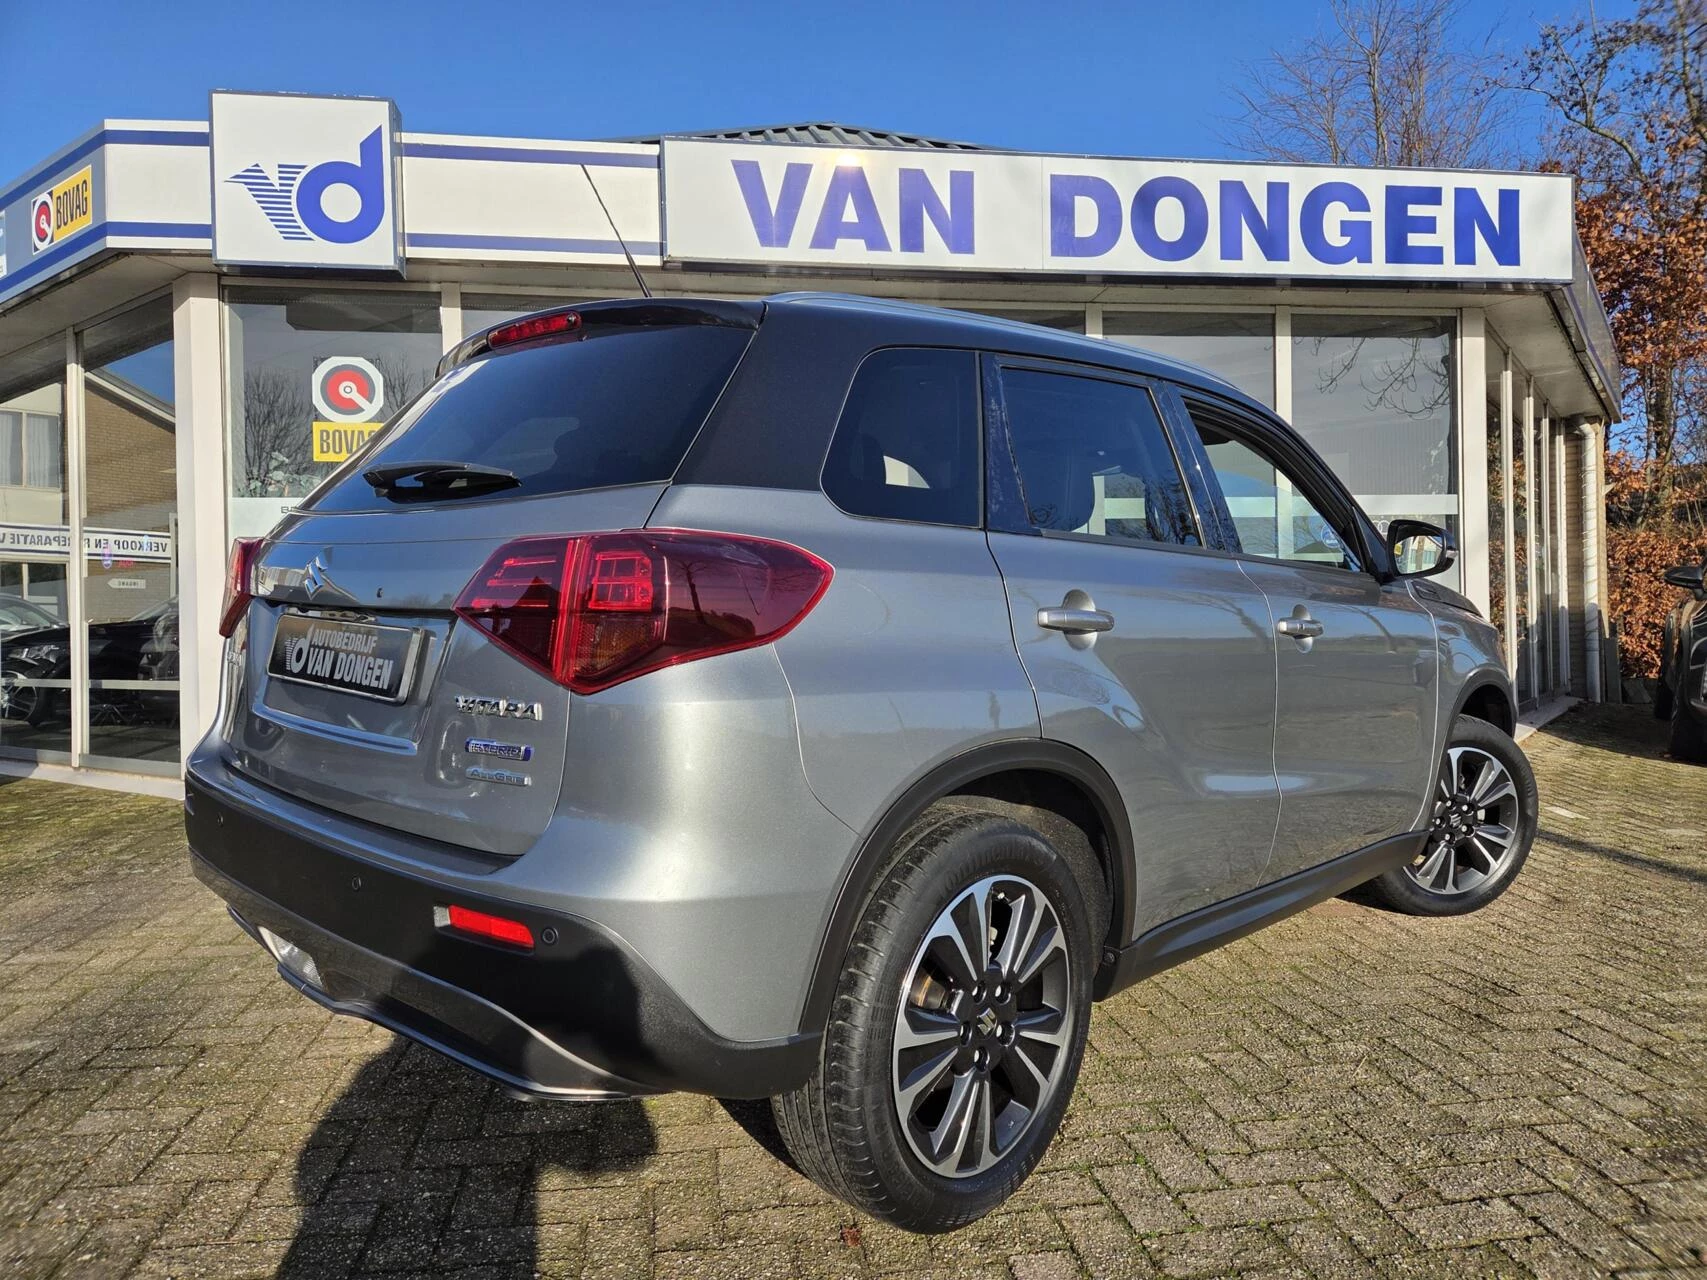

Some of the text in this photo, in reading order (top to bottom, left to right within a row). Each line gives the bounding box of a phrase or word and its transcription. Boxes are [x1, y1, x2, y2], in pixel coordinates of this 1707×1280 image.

[56, 179, 88, 230] BOVAG
[731, 159, 1521, 267] VAN DONGEN
[320, 429, 376, 455] BOVA
[311, 628, 378, 653] AUTOBEDRIJF
[306, 647, 394, 690] VAN DONGEN
[456, 695, 543, 721] VITARA
